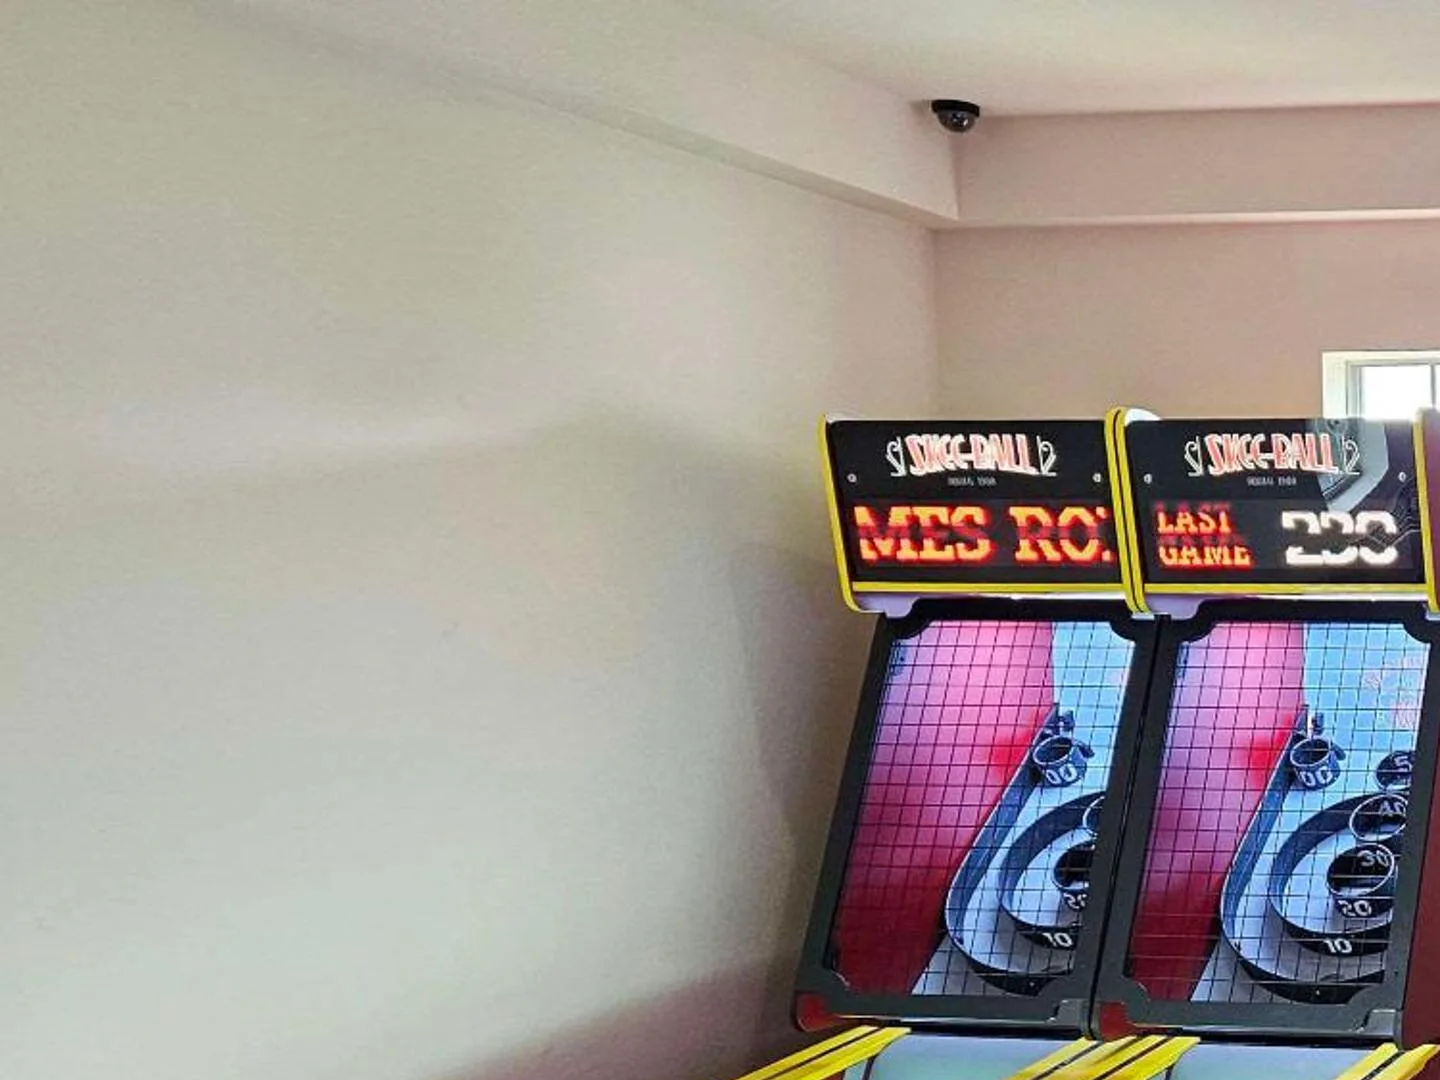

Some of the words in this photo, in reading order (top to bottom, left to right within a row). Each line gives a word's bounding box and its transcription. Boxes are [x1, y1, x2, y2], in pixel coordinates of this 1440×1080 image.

[1156, 502, 1232, 534] LAST
[853, 505, 993, 562] MES
[1157, 535, 1252, 567] GAME
[1357, 849, 1389, 867] 30
[1338, 900, 1372, 917] 20
[1324, 938, 1353, 954] 10
